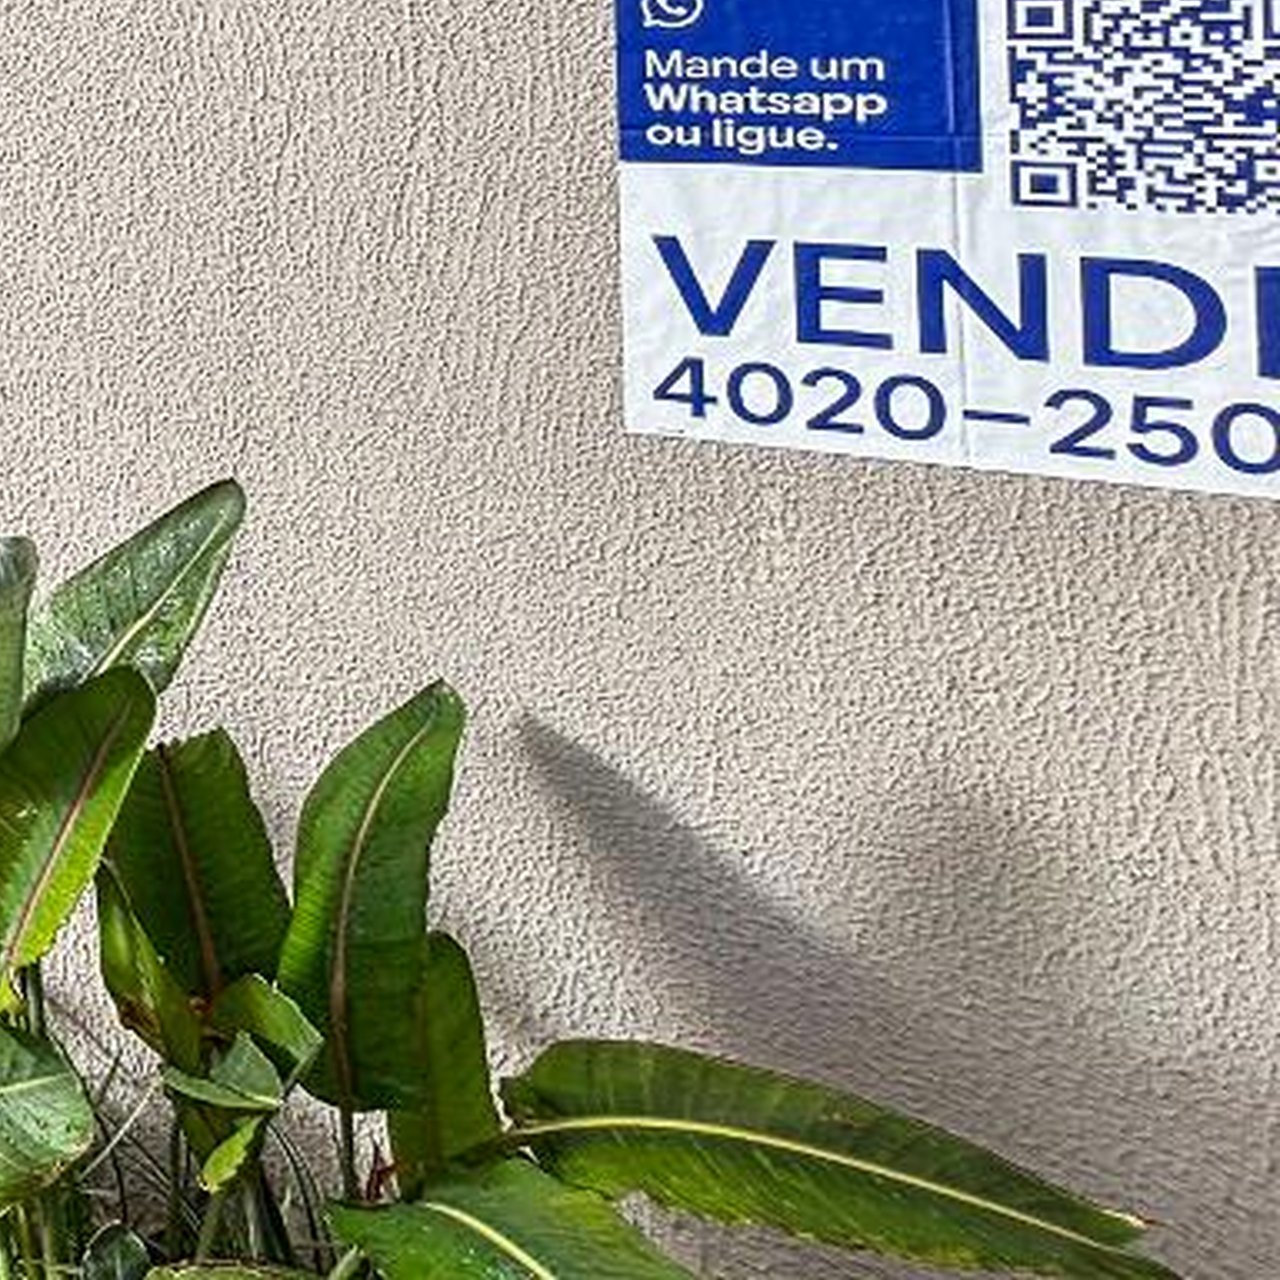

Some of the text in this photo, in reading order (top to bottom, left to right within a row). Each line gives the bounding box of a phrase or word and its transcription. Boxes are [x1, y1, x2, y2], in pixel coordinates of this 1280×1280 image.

[645, 49, 886, 81] Mande um
[643, 83, 888, 123] Whatsapp
[646, 119, 839, 154] ou ligue.
[652, 234, 1280, 379] VEND
[653, 356, 1280, 474] 4020-250
